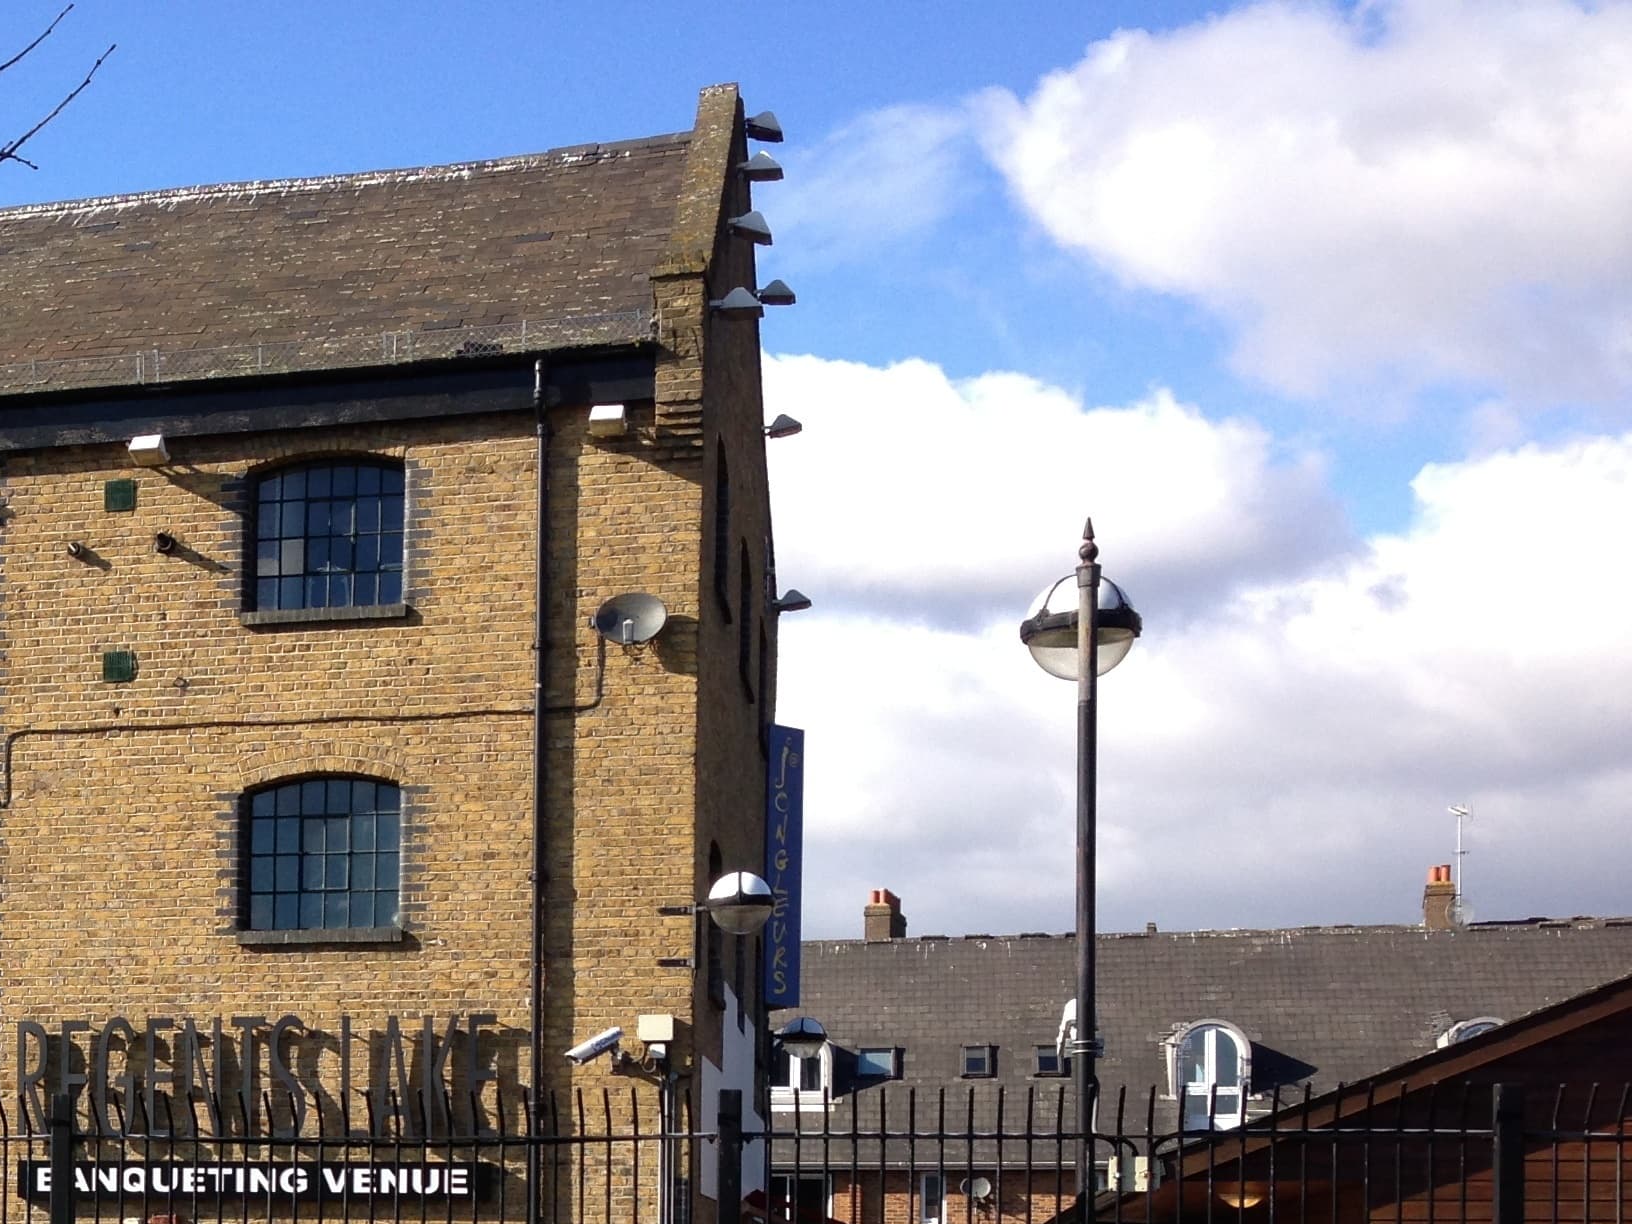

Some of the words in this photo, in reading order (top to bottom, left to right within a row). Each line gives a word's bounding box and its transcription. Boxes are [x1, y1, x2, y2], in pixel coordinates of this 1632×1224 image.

[17, 1016, 307, 1139] REGENTS
[341, 1014, 498, 1140] LAKE
[322, 1167, 468, 1195] VENUE
